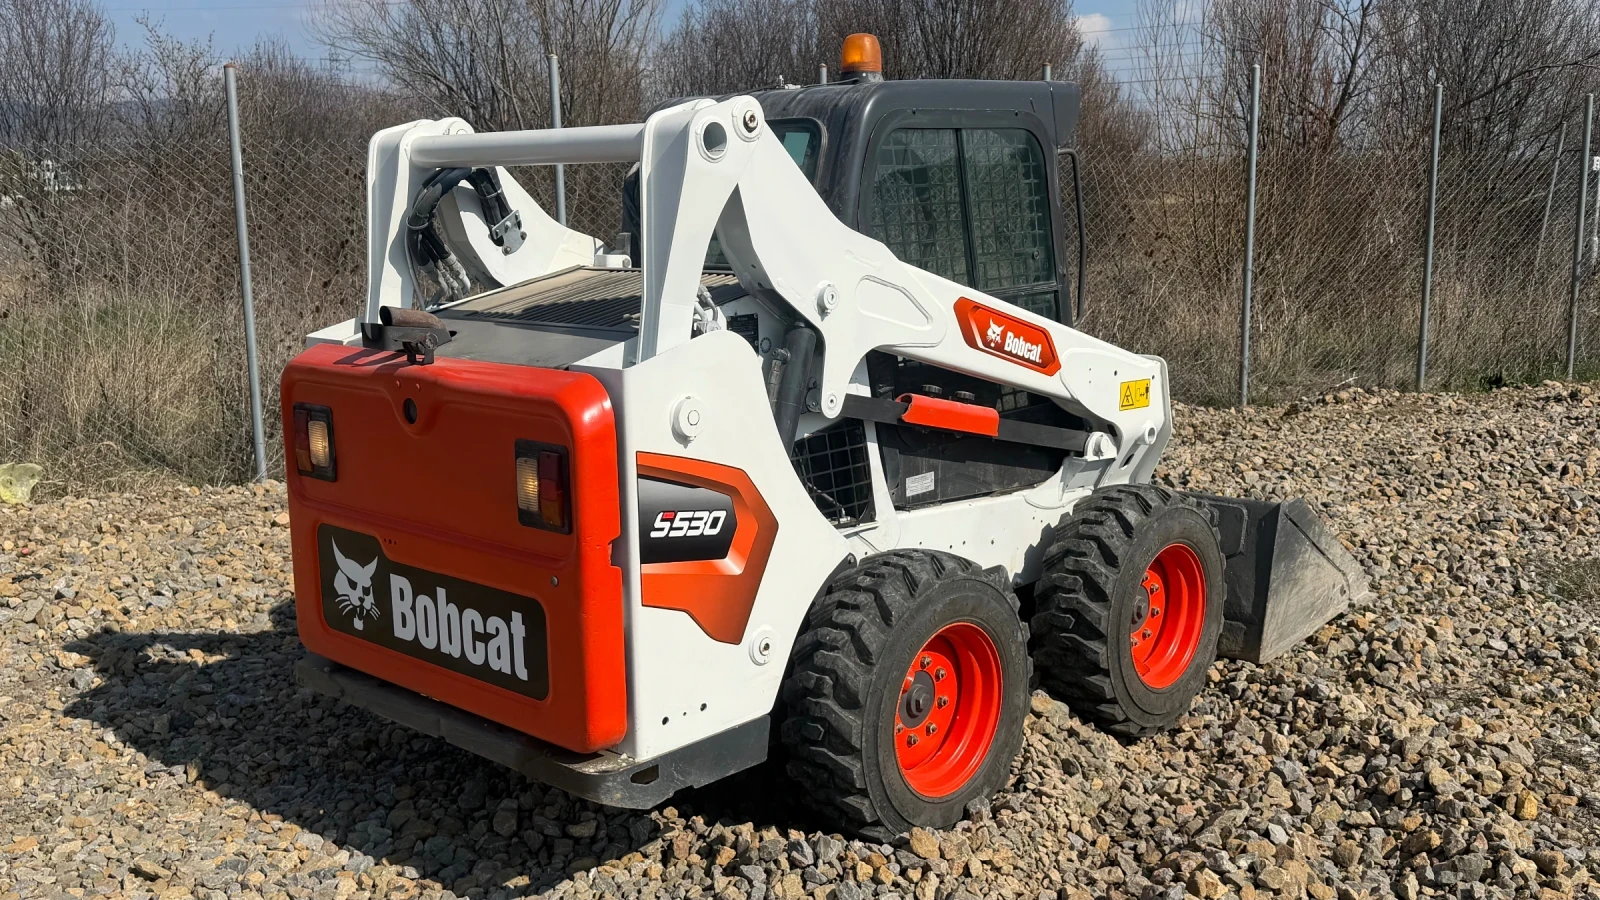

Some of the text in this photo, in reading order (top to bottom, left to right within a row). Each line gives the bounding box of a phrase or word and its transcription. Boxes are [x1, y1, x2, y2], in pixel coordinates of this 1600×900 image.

[1004, 331, 1042, 363] Bobcat
[650, 510, 727, 538] S530
[389, 573, 528, 681] Bobcat
